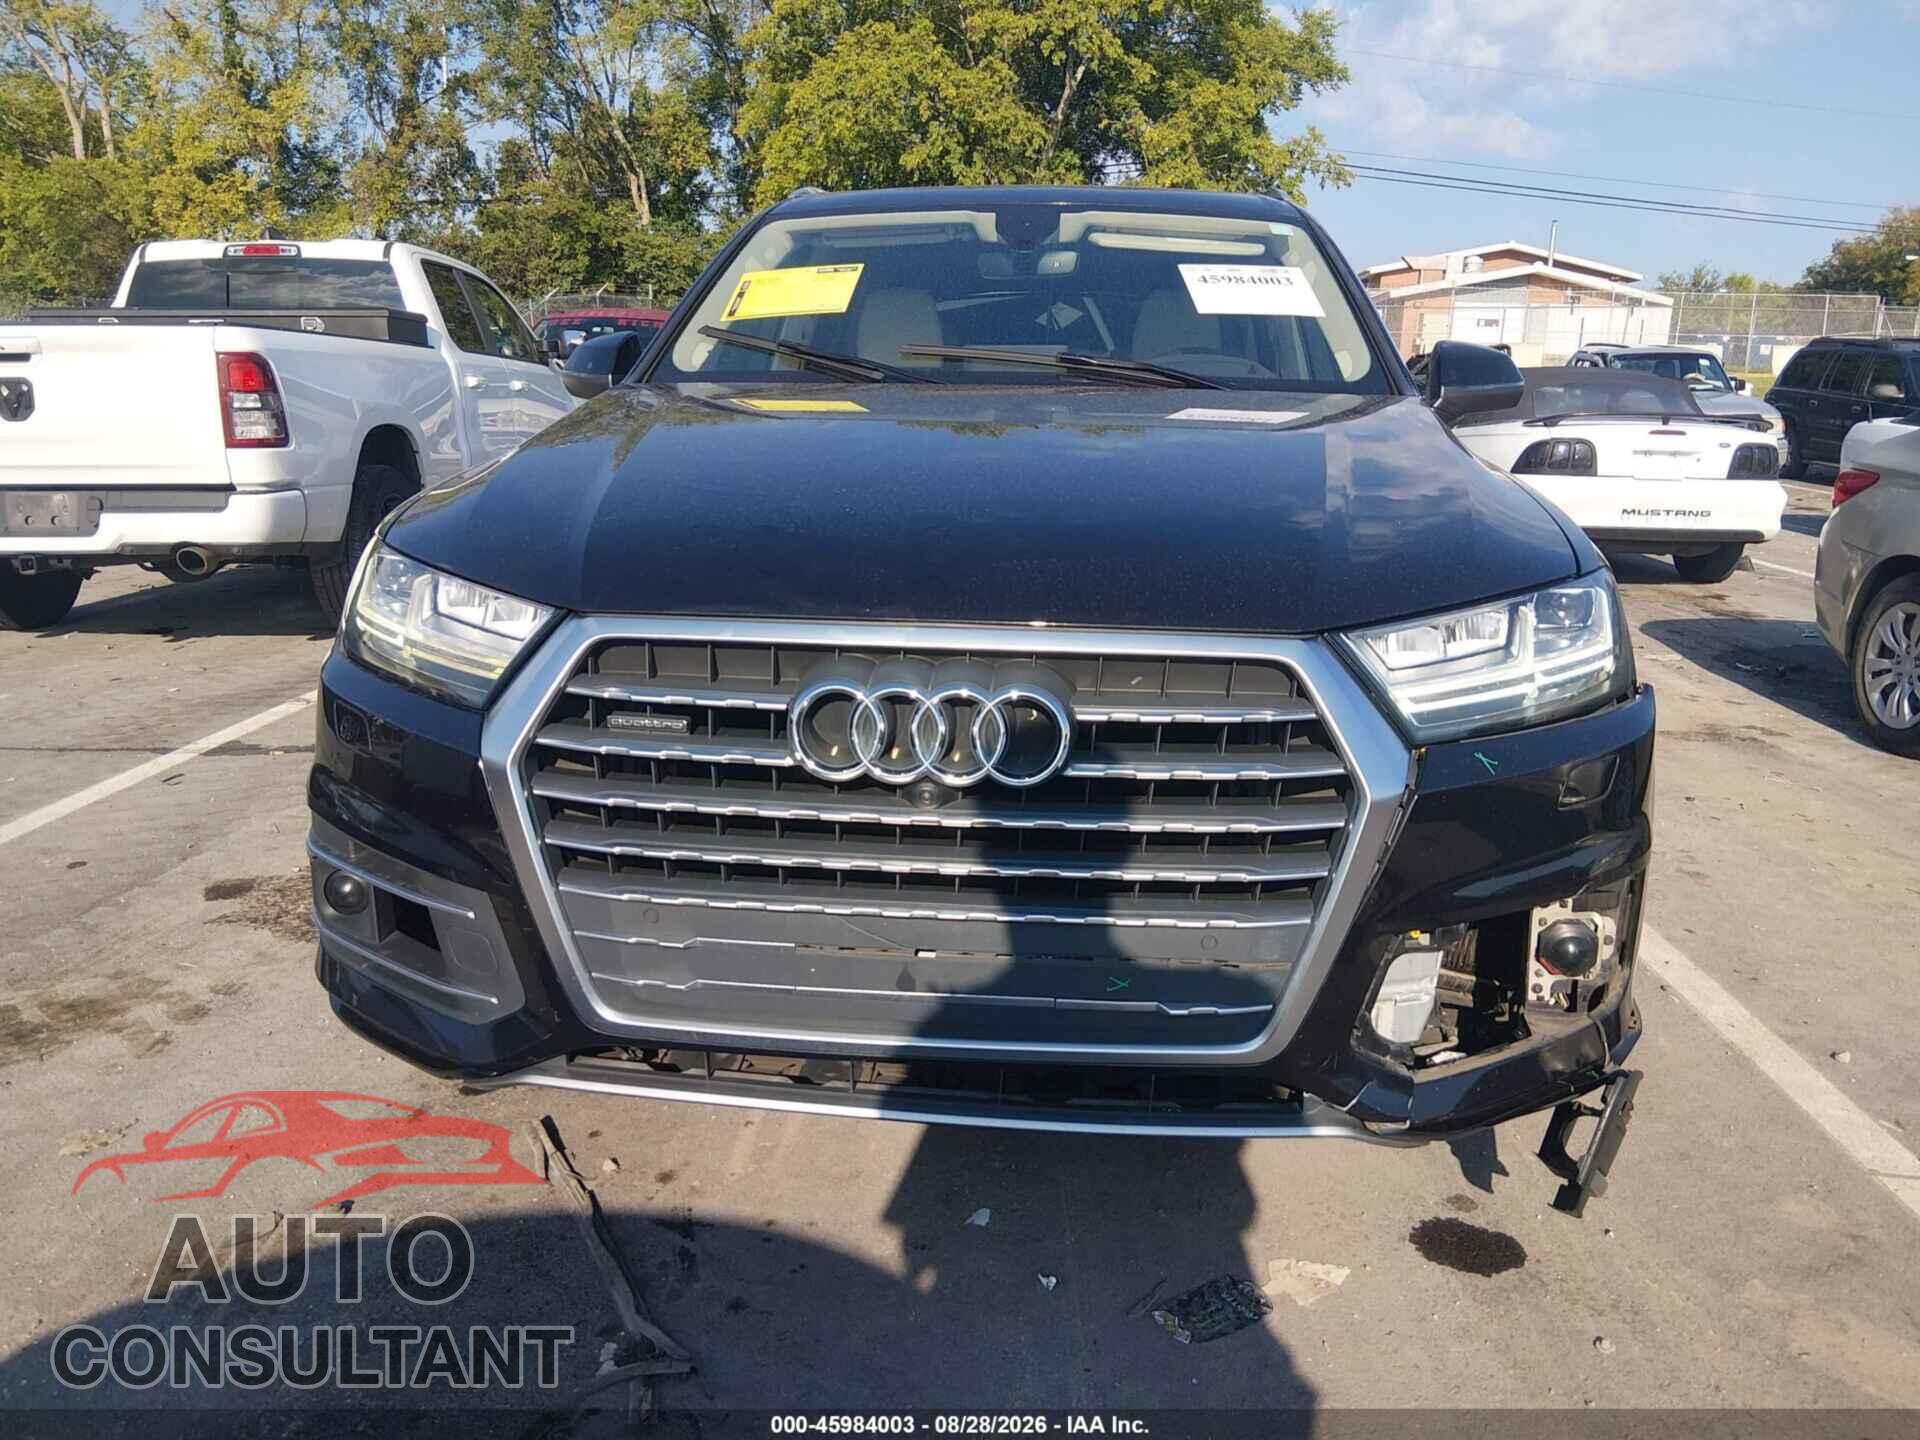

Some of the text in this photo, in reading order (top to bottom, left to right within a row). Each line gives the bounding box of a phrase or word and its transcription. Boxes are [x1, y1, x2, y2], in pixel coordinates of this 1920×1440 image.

[1197, 274, 1294, 287] 45984003
[1621, 508, 1712, 518] MUSTANG
[610, 717, 685, 730] quattro
